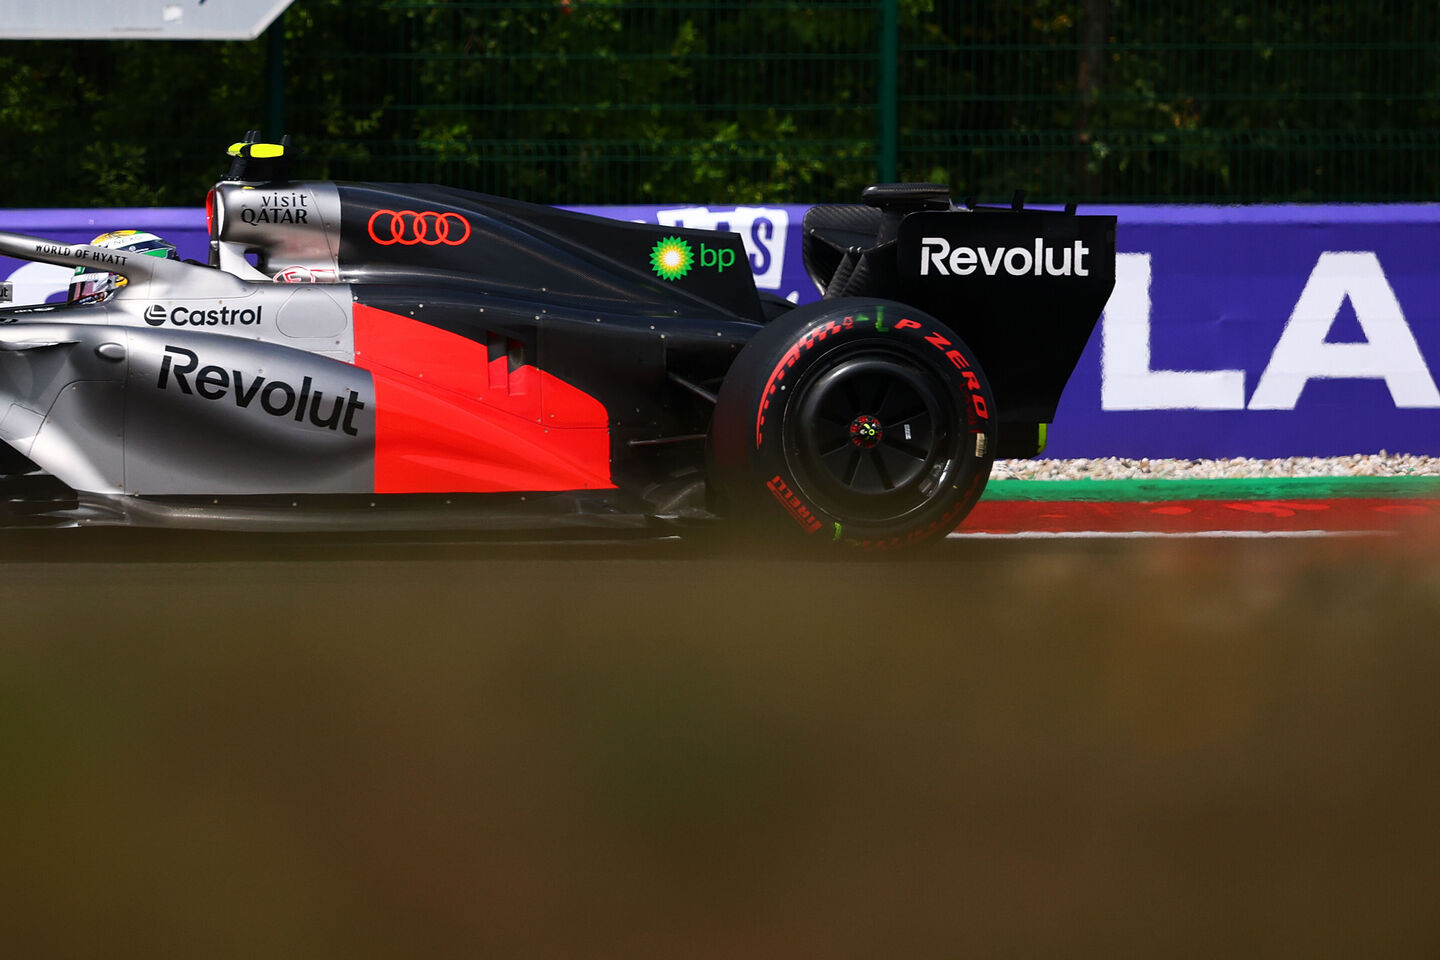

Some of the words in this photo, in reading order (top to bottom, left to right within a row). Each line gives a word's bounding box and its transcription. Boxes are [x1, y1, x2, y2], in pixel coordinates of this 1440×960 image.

[261, 192, 308, 208] visit
[240, 207, 308, 226] QATAR
[35, 244, 71, 257] WORLD
[75, 249, 90, 260] OF
[92, 253, 128, 266] HYATT
[700, 242, 736, 273] bp
[920, 237, 1090, 277] Revolut
[170, 305, 262, 327] Castrol
[924, 331, 989, 420] ZERO
[157, 345, 365, 437] Revolut
